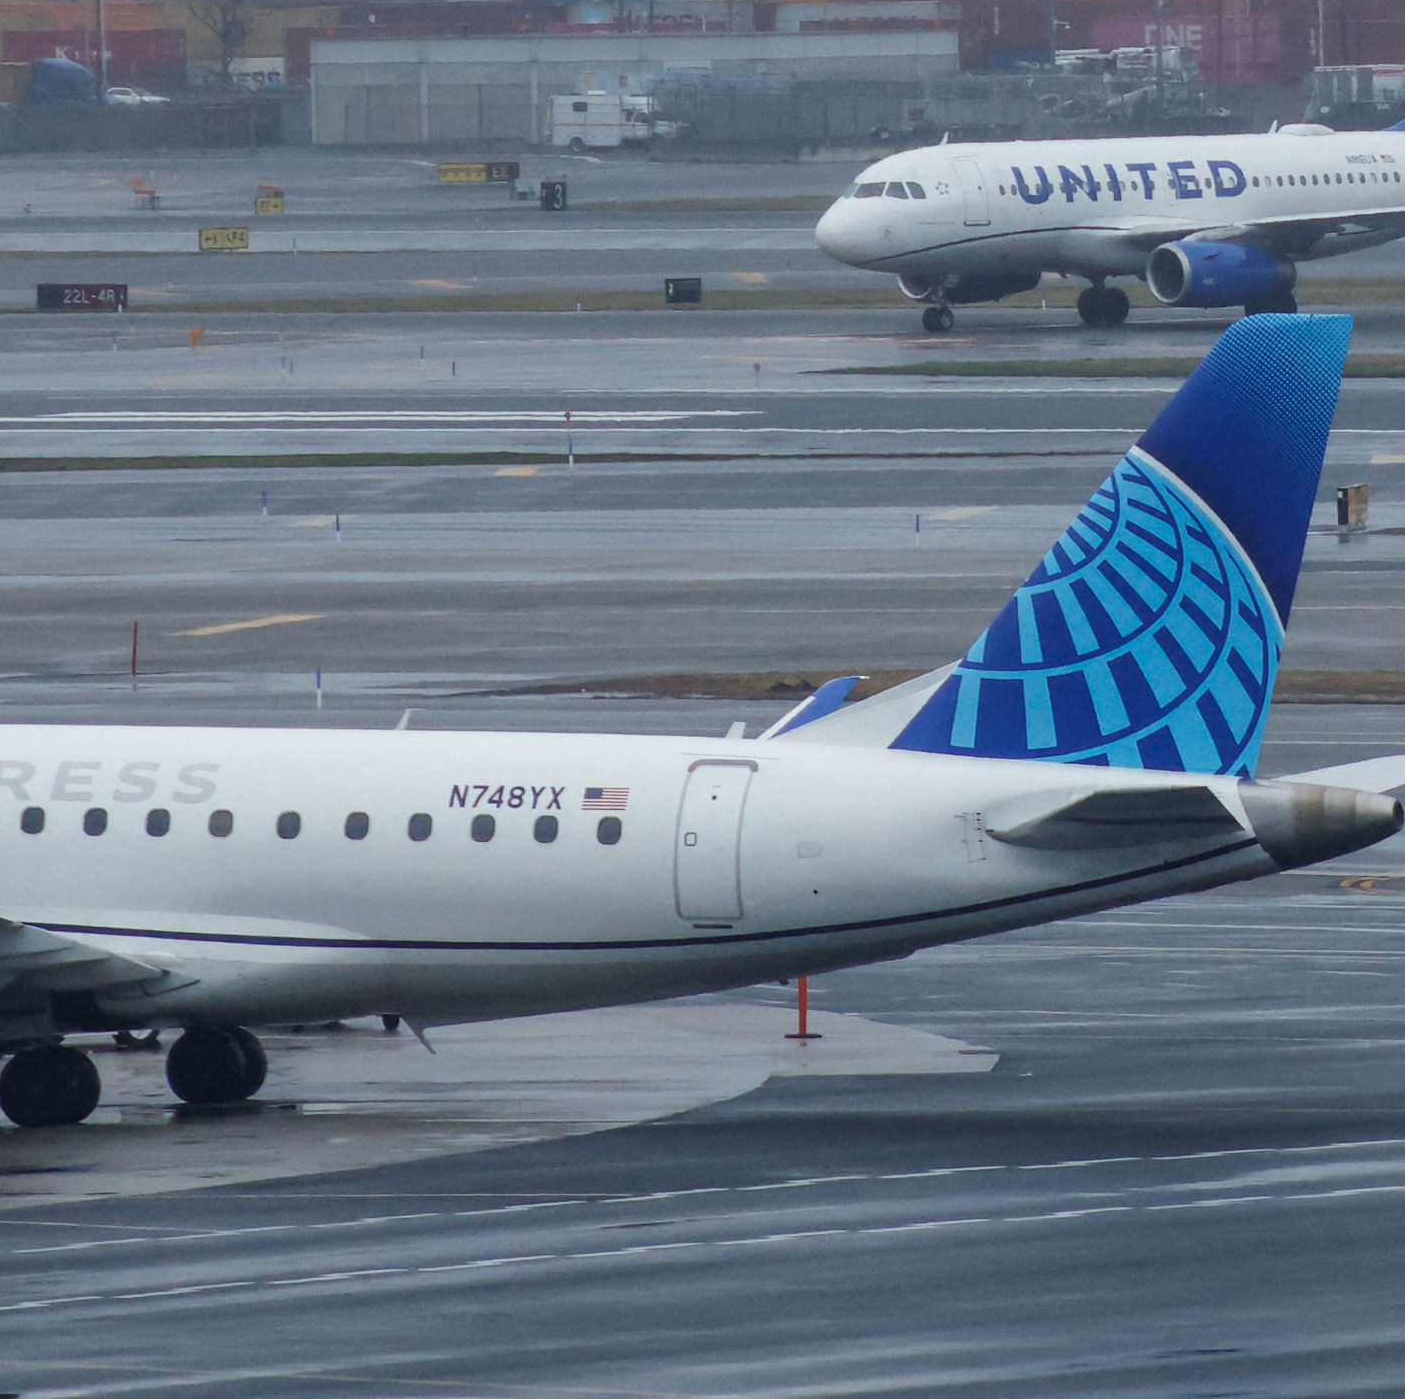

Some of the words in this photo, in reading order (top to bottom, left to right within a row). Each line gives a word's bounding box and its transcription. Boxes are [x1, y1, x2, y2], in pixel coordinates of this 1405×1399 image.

[1010, 160, 1247, 205] UNITED
[554, 184, 564, 210] 3
[63, 288, 116, 304] 22L-4R
[448, 784, 566, 810] N748YX
